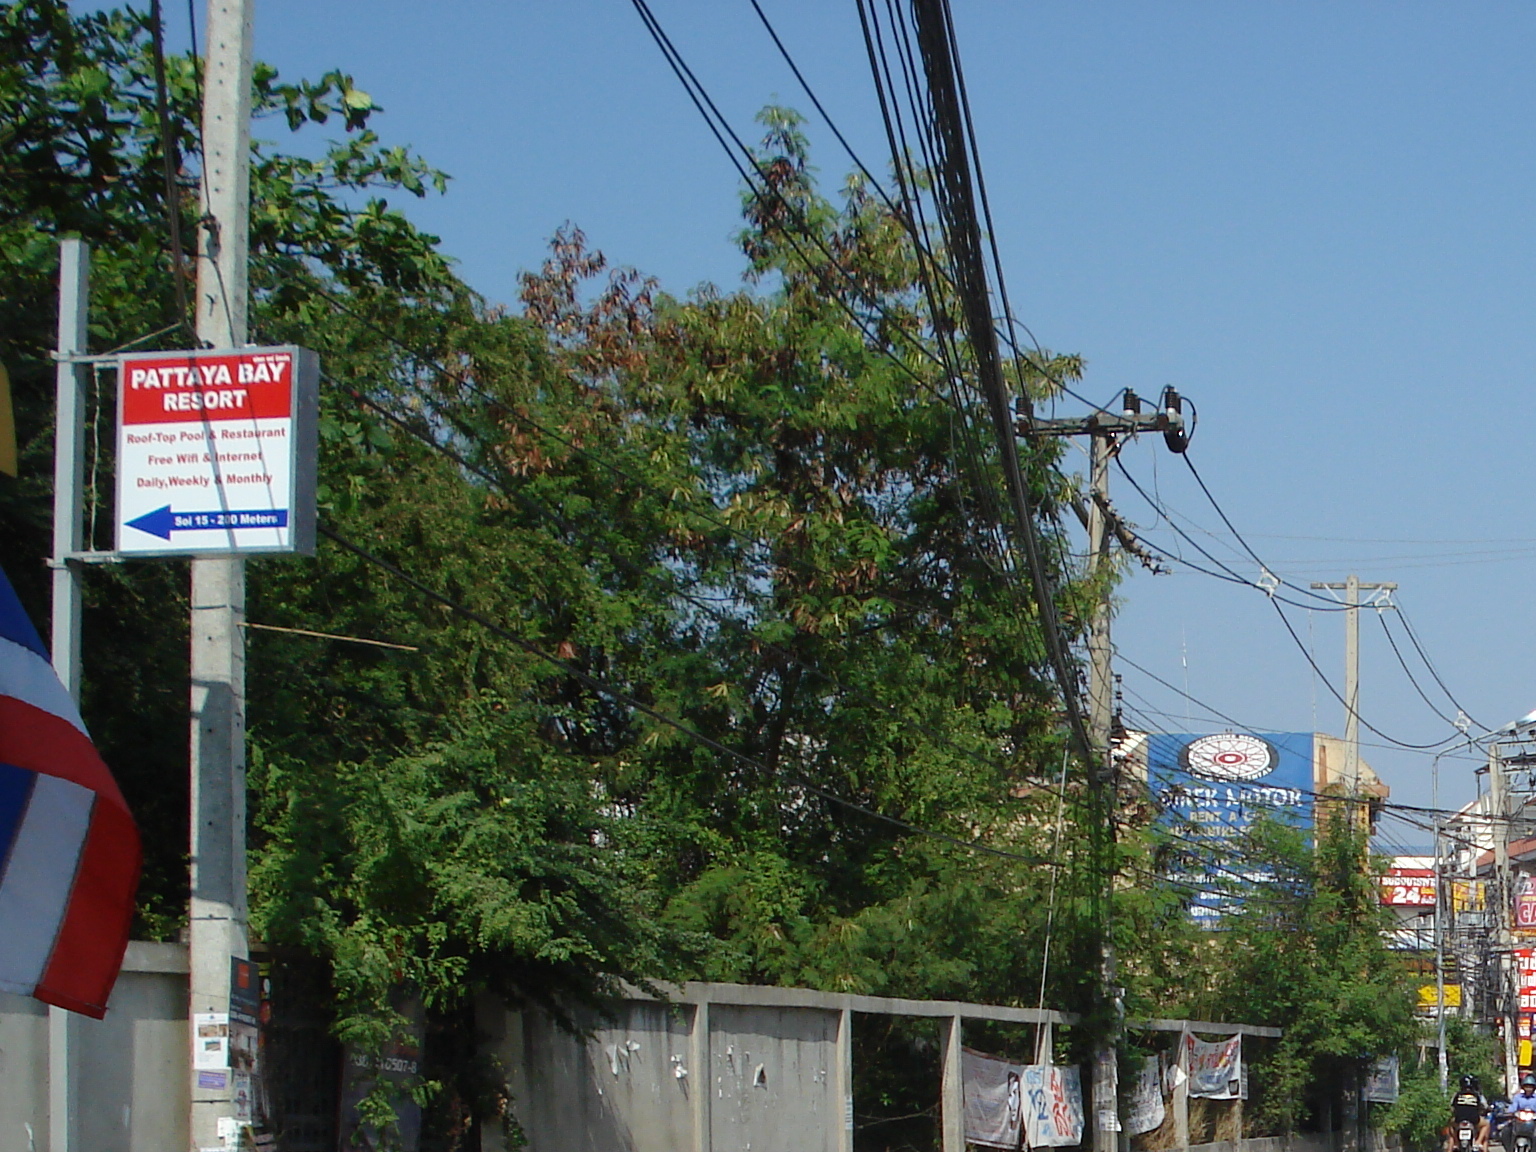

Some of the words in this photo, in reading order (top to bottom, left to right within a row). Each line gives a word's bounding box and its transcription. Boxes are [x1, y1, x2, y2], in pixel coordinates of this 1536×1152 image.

[131, 365, 232, 389] PATTAYA
[238, 362, 286, 384] BAY
[163, 390, 247, 412] RESORT
[127, 432, 176, 445] Roof-Top
[180, 431, 205, 442] Pool
[209, 430, 217, 440] &
[221, 427, 286, 440] Restaurant
[148, 453, 173, 466] Free
[176, 452, 198, 464] Wifi
[203, 452, 211, 462] &
[215, 451, 263, 462] Internet
[136, 475, 210, 488] Daily,Weekly
[214, 475, 222, 484] &
[226, 472, 272, 485] Monthly
[175, 516, 193, 527] Soi
[196, 515, 209, 526] 15
[217, 514, 237, 525] 200
[240, 514, 278, 525] Meters
[1190, 811, 1223, 823] RENT
[1228, 811, 1238, 823] A
[1392, 887, 1421, 903] 24
